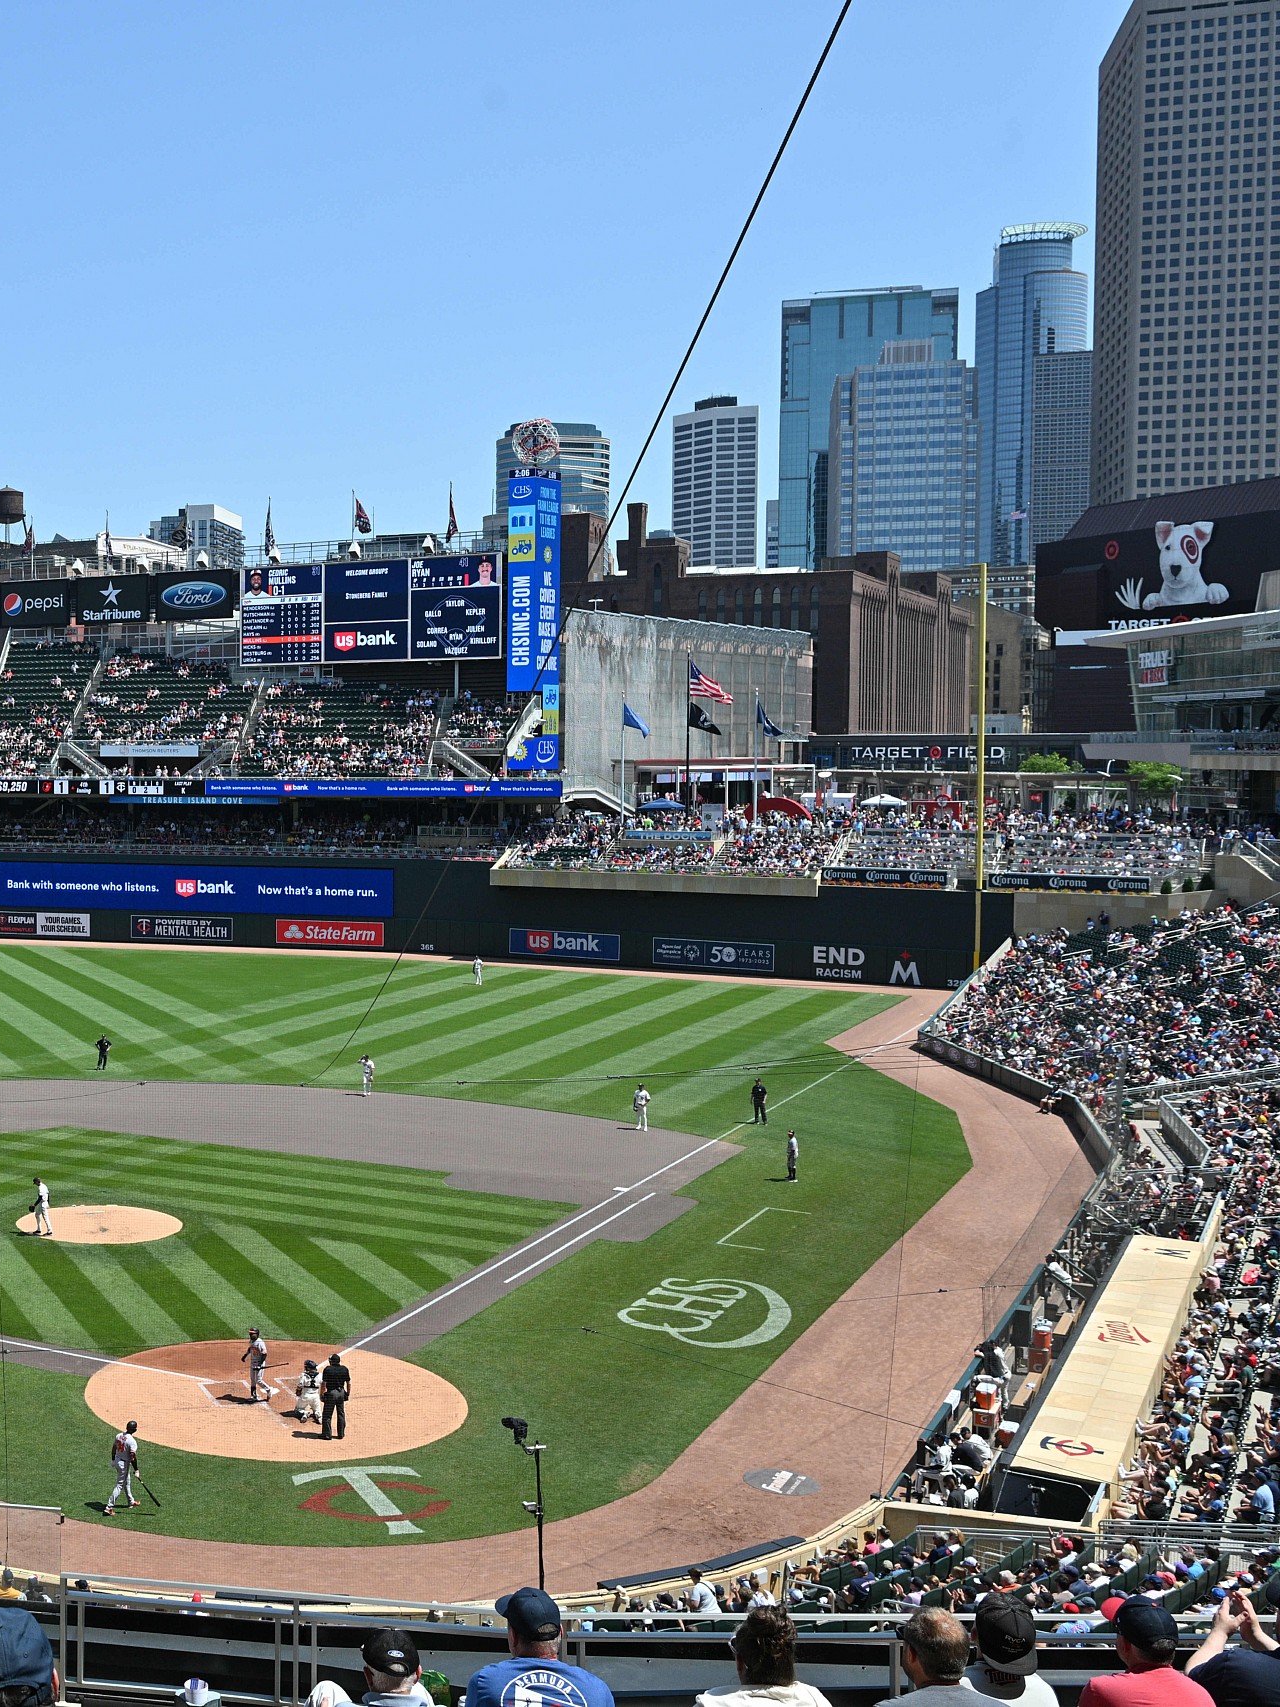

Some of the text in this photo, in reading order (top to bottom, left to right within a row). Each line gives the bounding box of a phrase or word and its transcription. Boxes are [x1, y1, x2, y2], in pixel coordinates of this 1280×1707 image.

[515, 469, 530, 477] 2:06
[514, 485, 530, 494] CHS
[412, 561, 424, 569] JOE
[268, 569, 288, 577] CEDRIC
[412, 568, 430, 577] RYAN
[268, 576, 296, 585] MULLINS
[173, 586, 212, 605] Ford
[24, 593, 64, 613] pepsi
[82, 609, 141, 621] StarTribune
[512, 575, 530, 666] CHSINC.COM
[466, 625, 484, 633] JULIEN
[1108, 619, 1171, 631] TARGET
[336, 635, 354, 647] us
[1140, 650, 1169, 669] TRULY
[538, 741, 555, 755] CHS
[852, 747, 1005, 759] TARGET FIELD
[142, 796, 243, 805] TREASURE ISLAND COVE
[640, 832, 698, 841] THE DOCK
[823, 869, 857, 880] Corona
[866, 871, 900, 881] Corona
[909, 872, 945, 883] Corona
[991, 873, 1029, 886] Corona
[7, 879, 159, 893] Bank with someone who listens.
[177, 881, 195, 893] us
[1049, 876, 1087, 888] Corona
[1108, 879, 1147, 891] Corona
[257, 885, 378, 897] Now that's a home run.
[8, 915, 35, 925] FLEXPLAN
[45, 916, 82, 925] YOUR GAMES.
[40, 924, 56, 932] YOUR
[56, 925, 87, 934] SCHEDULE.
[154, 925, 227, 938] MENTAL HEALTH
[529, 935, 550, 948] us
[737, 949, 770, 959] YEARS
[813, 946, 865, 966] END
[816, 967, 862, 979] RACISM
[617, 1277, 748, 1333] CHS
[515, 1672, 572, 1694] BERMUDA
